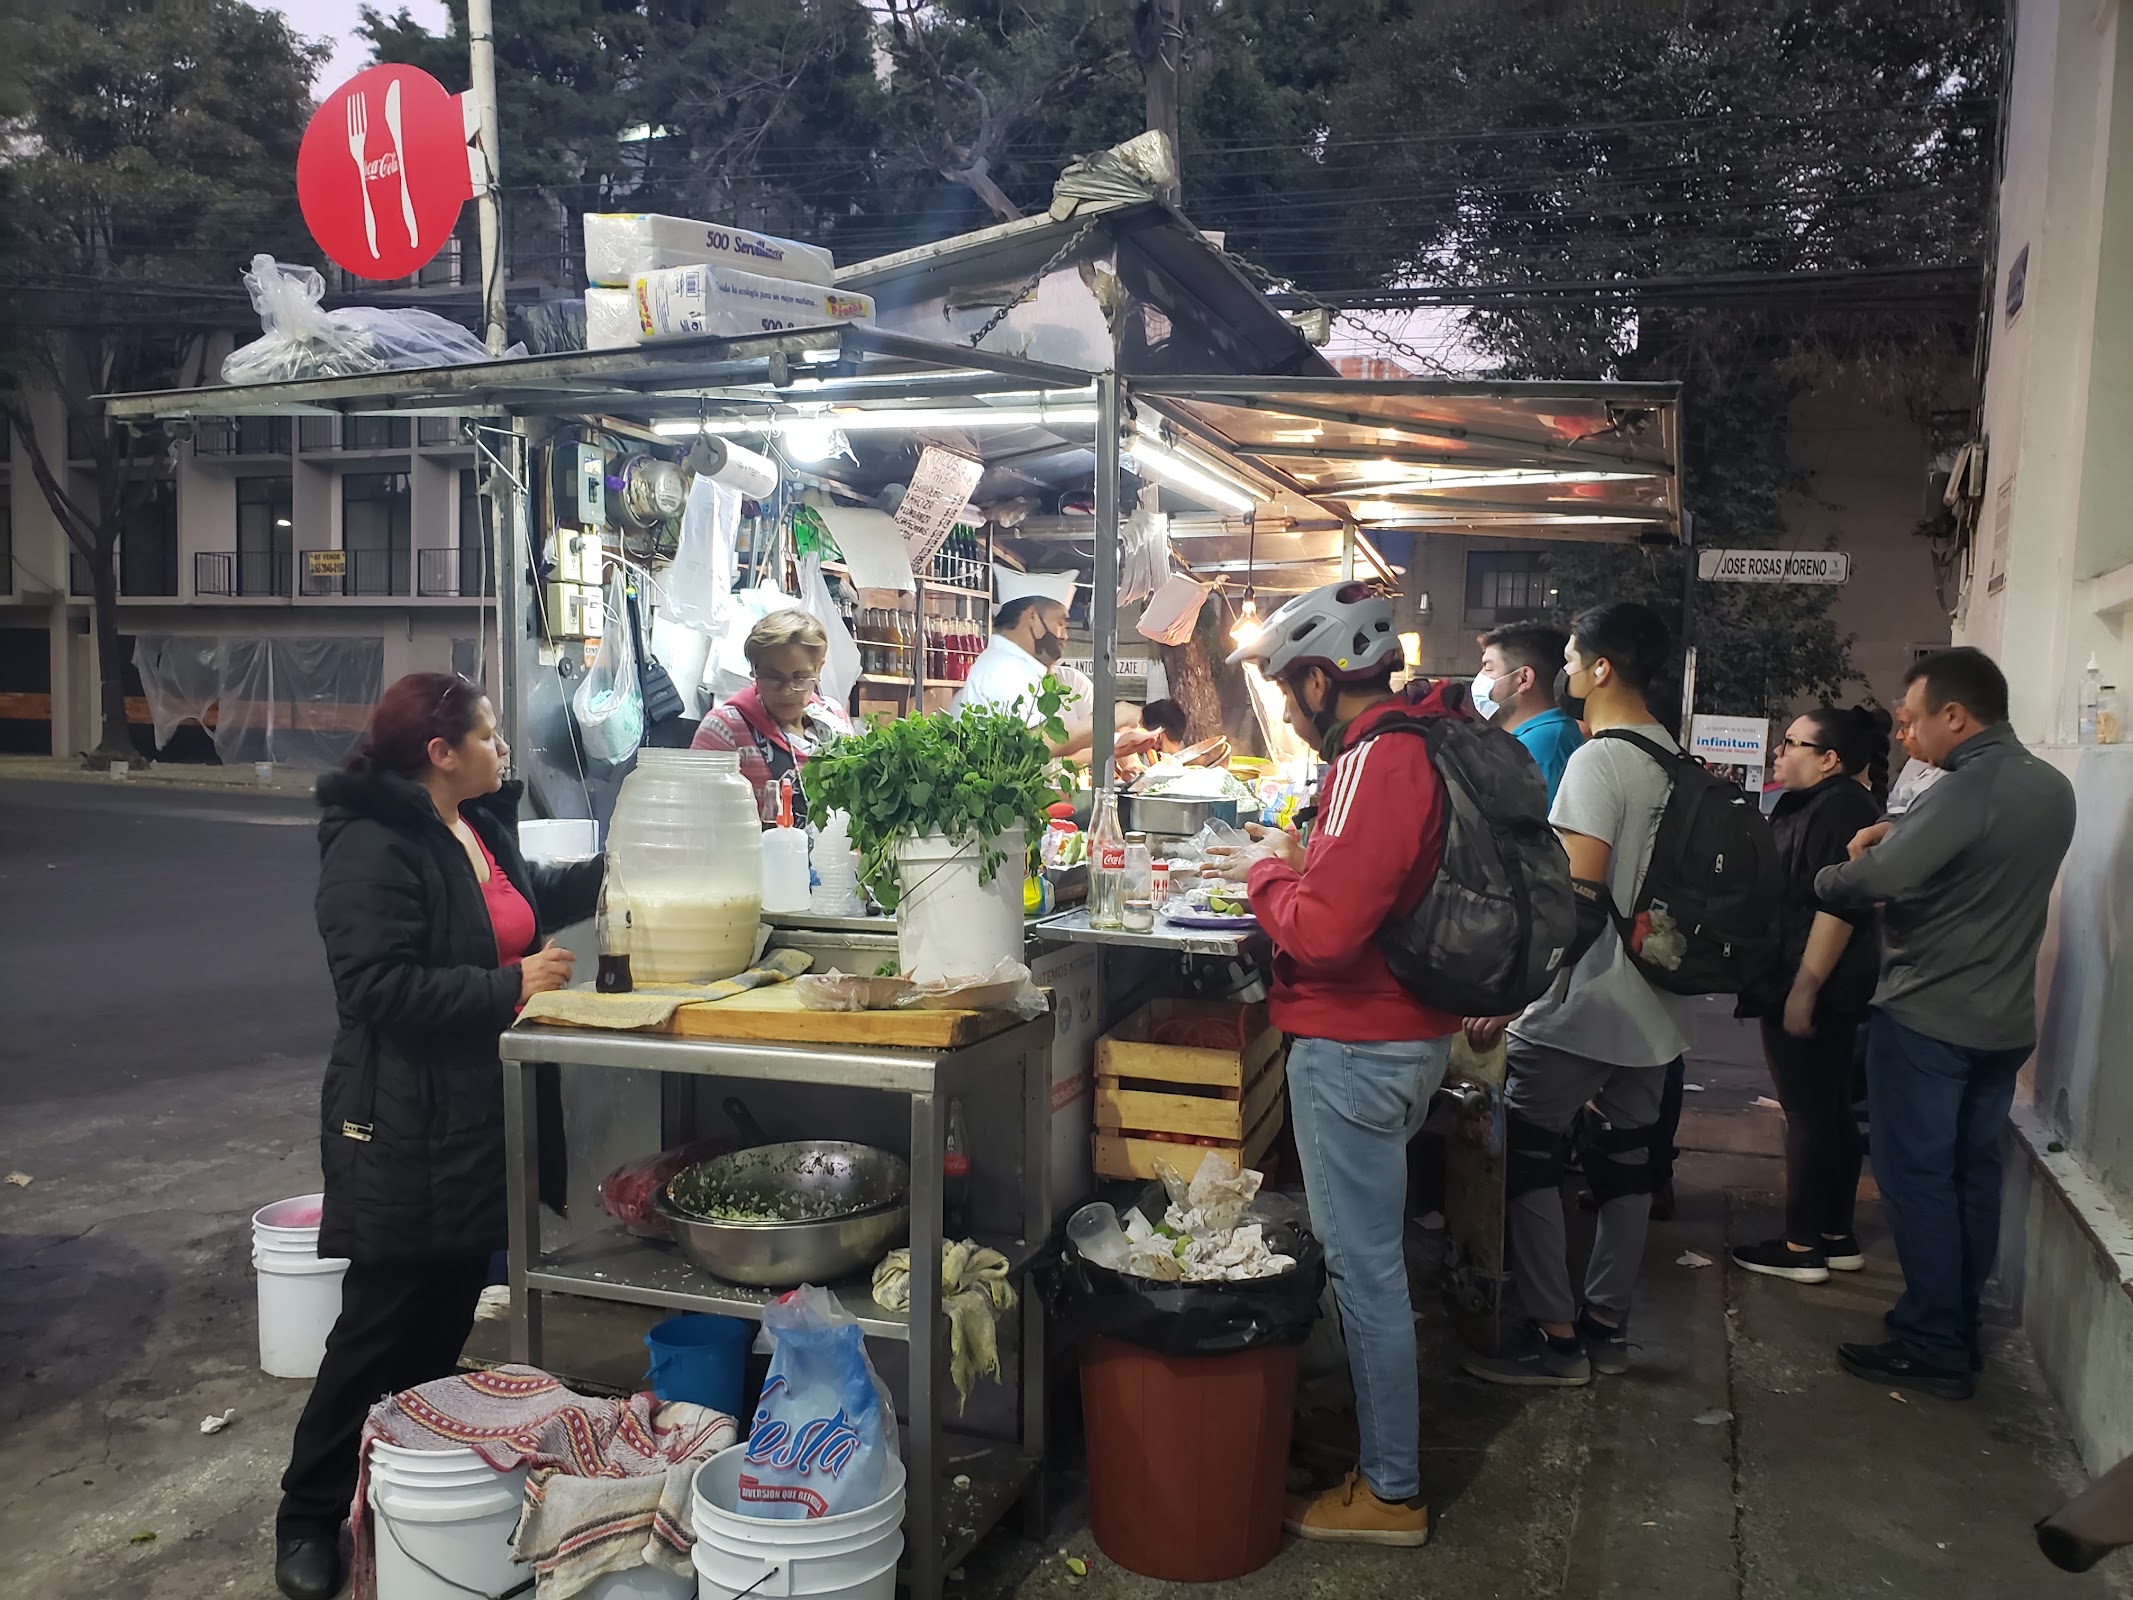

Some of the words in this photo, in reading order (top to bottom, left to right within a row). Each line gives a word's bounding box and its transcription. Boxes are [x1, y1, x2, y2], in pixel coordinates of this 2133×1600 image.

[706, 230, 730, 251] 500
[1721, 557, 1746, 575] JOSE
[1748, 558, 1782, 575] ROSAS
[1784, 558, 1827, 576] MORENO
[1115, 661, 1138, 674] LZATE
[1697, 736, 1759, 748] infinitum
[781, 1489, 797, 1500] QUE
